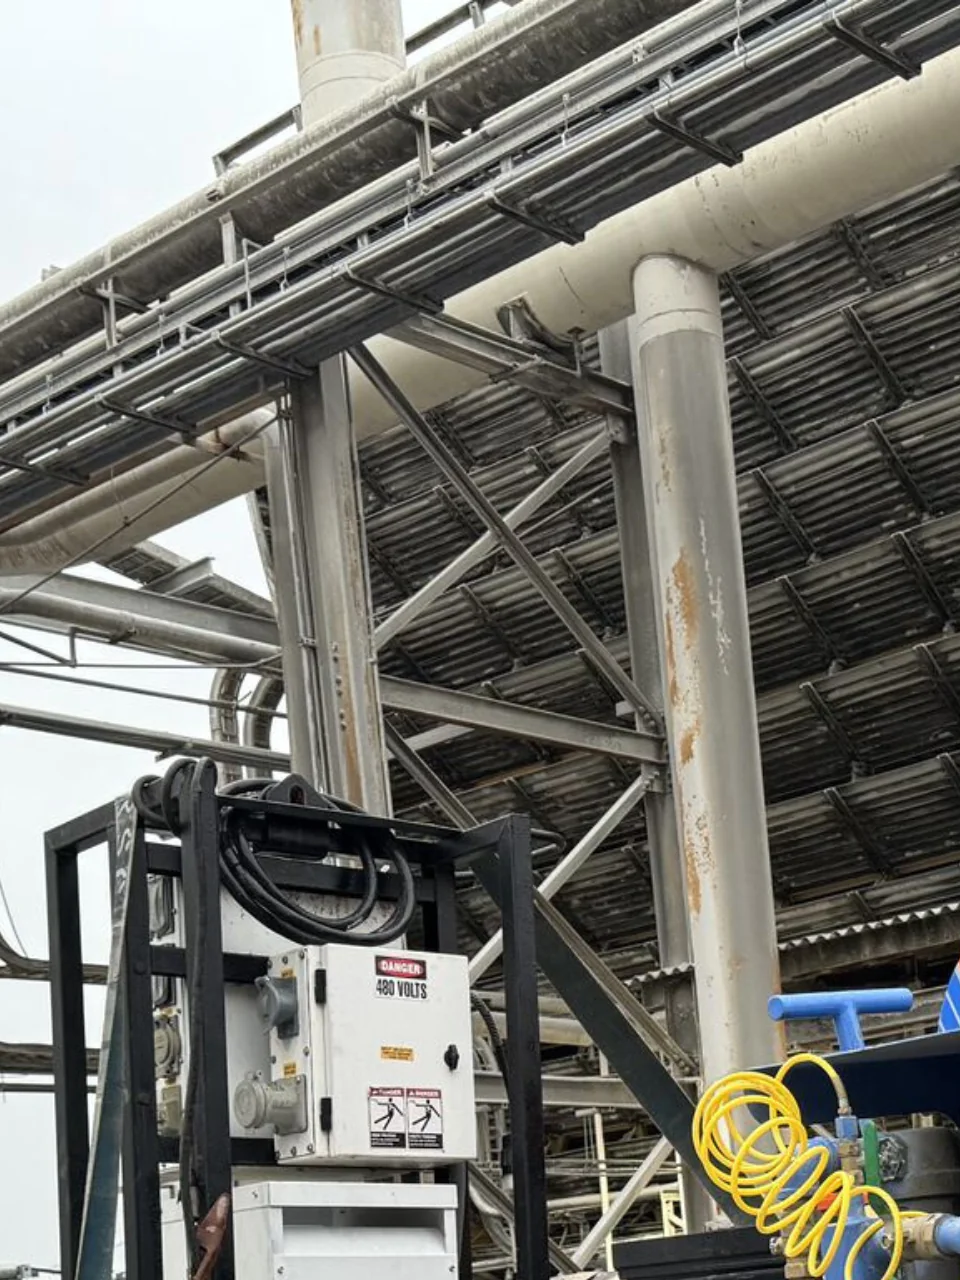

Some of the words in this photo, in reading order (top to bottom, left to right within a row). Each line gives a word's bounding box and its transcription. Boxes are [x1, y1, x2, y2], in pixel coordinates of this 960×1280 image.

[380, 960, 423, 975] DANGER
[376, 978, 395, 996] 480
[397, 980, 427, 999] VOLTS
